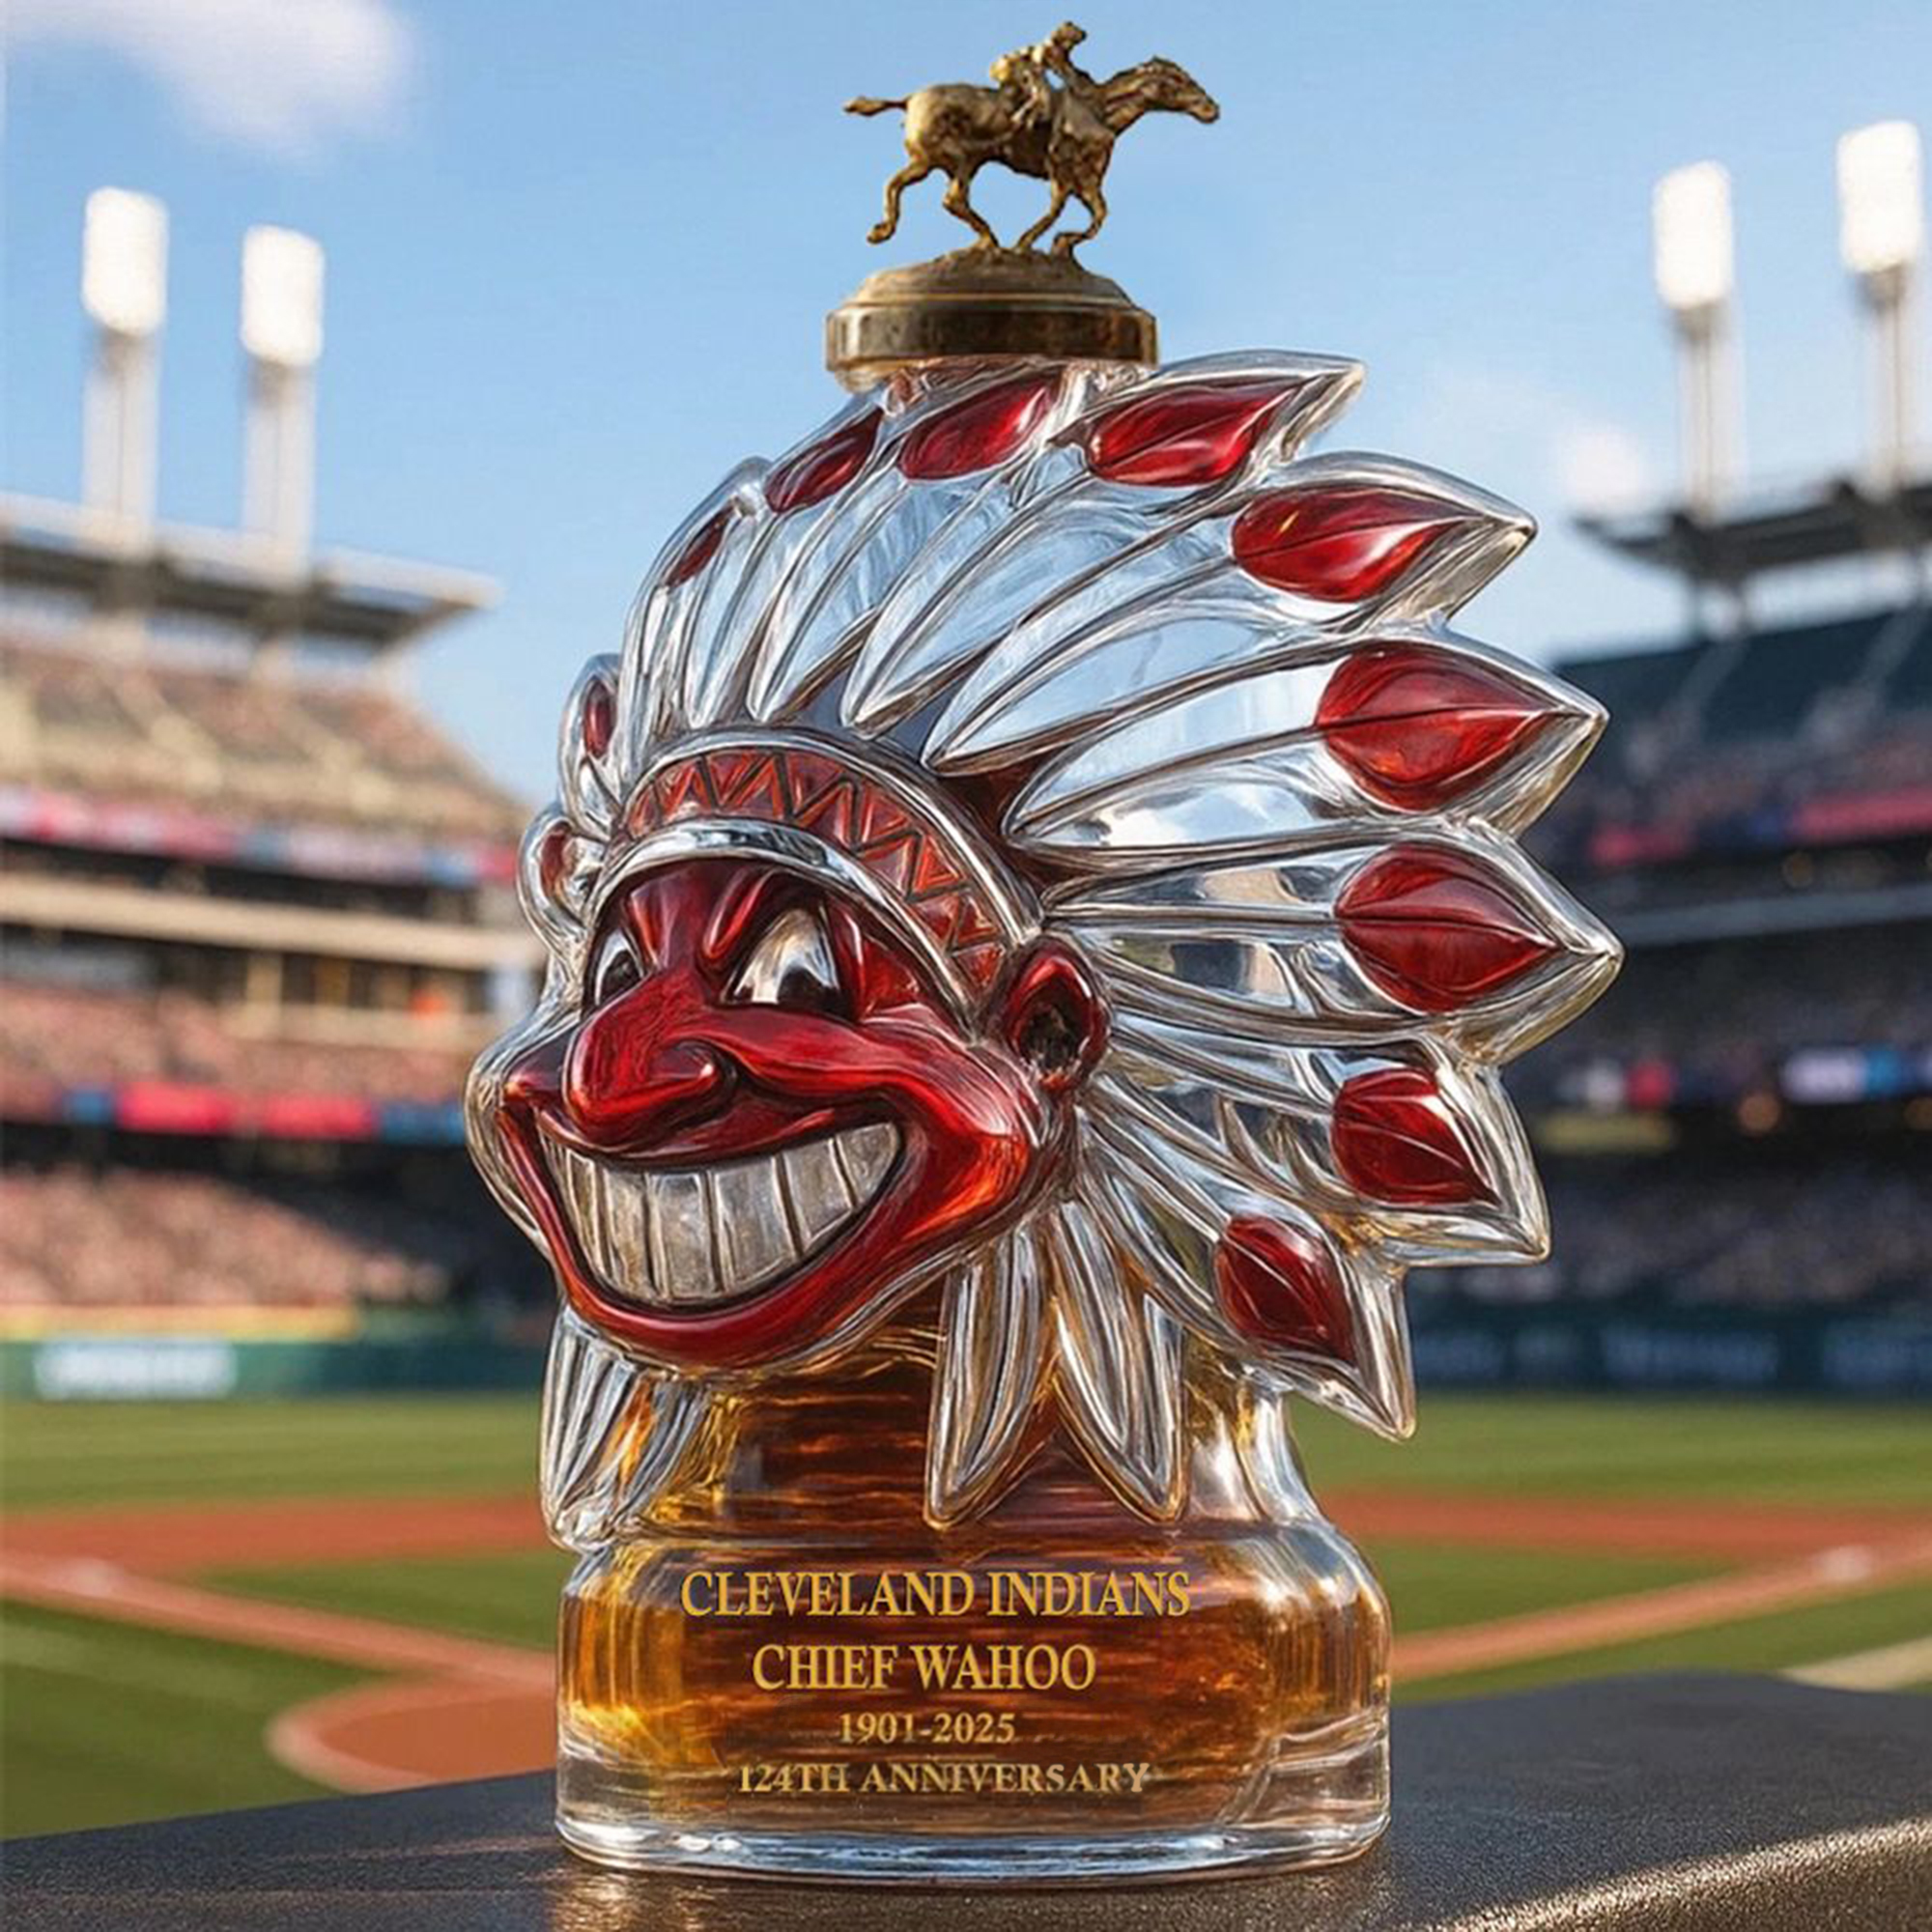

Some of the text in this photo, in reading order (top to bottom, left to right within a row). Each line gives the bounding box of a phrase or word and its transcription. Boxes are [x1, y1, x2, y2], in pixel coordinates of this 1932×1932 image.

[680, 1571, 1191, 1617] CLEVELAND INDIANS
[752, 1643, 1097, 1691] CHIEF WAHOO
[838, 1713, 1016, 1745] 1901-2025
[738, 1763, 1151, 1794] 124TH ANNIVERSARY
